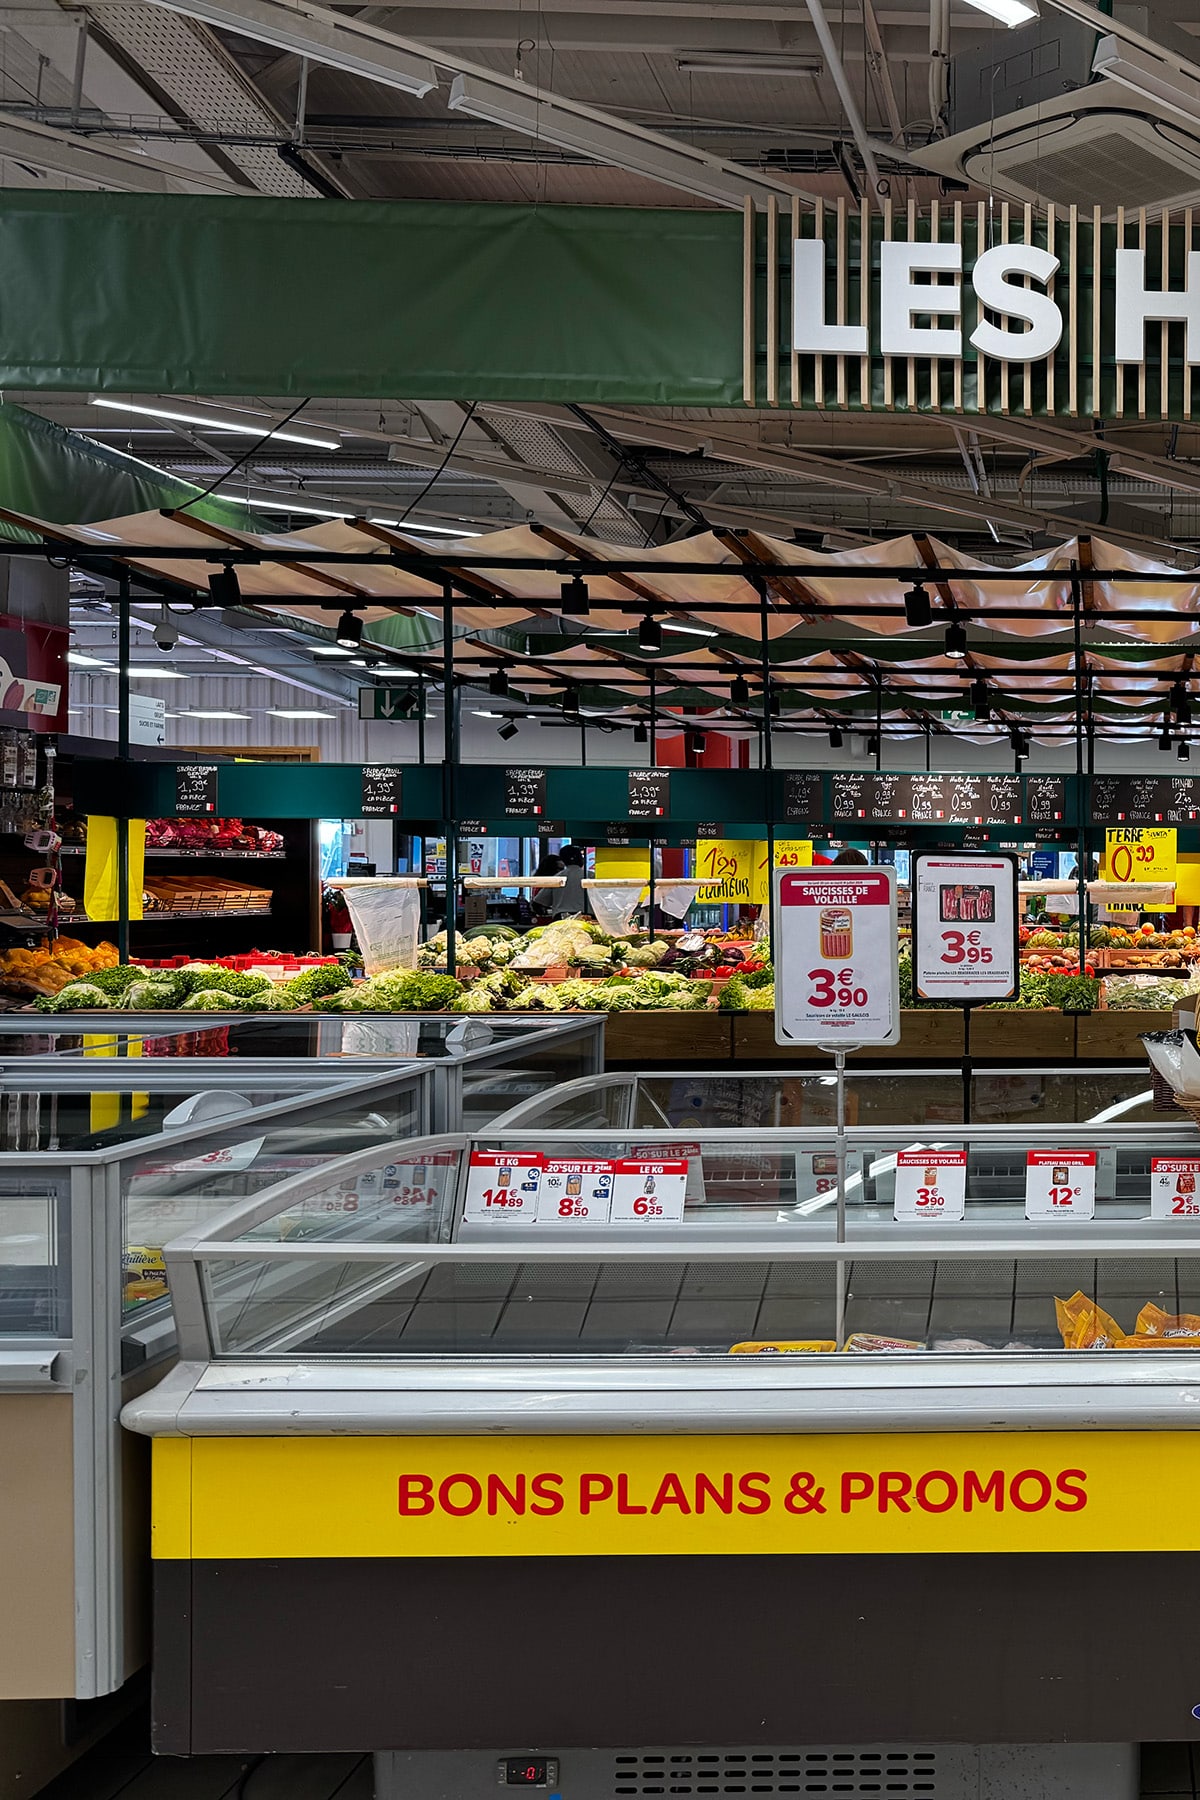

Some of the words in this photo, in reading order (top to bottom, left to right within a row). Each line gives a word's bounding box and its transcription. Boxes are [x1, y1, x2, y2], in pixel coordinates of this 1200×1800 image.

[793, 239, 1063, 363] LES
[1107, 828, 1144, 843] TERRE
[803, 887, 855, 896] SAUCISSES
[856, 887, 868, 895] DE
[814, 896, 858, 904] VOLAILLE
[940, 930, 993, 964] 3€95
[807, 968, 868, 1008] 3€90
[495, 1158, 505, 1166] LE
[506, 1158, 519, 1166] KG
[650, 1150, 668, 1158] SUR
[562, 1165, 582, 1173] SUR
[583, 1165, 593, 1173] LE
[640, 1166, 650, 1174] LE
[651, 1166, 664, 1174] KG
[1170, 1164, 1187, 1172] SUR
[1189, 1164, 1200, 1172] LE
[482, 1189, 523, 1208] 14€89
[915, 1188, 945, 1206] 3€90
[1048, 1187, 1081, 1206] 12€
[1171, 1196, 1200, 1214] 2€25
[558, 1196, 588, 1217] 8€50
[633, 1196, 663, 1216] 6€35
[398, 1473, 565, 1517] BONS
[579, 1472, 771, 1515] PLANS
[784, 1471, 827, 1515] &
[840, 1469, 1088, 1514] PROMOS
